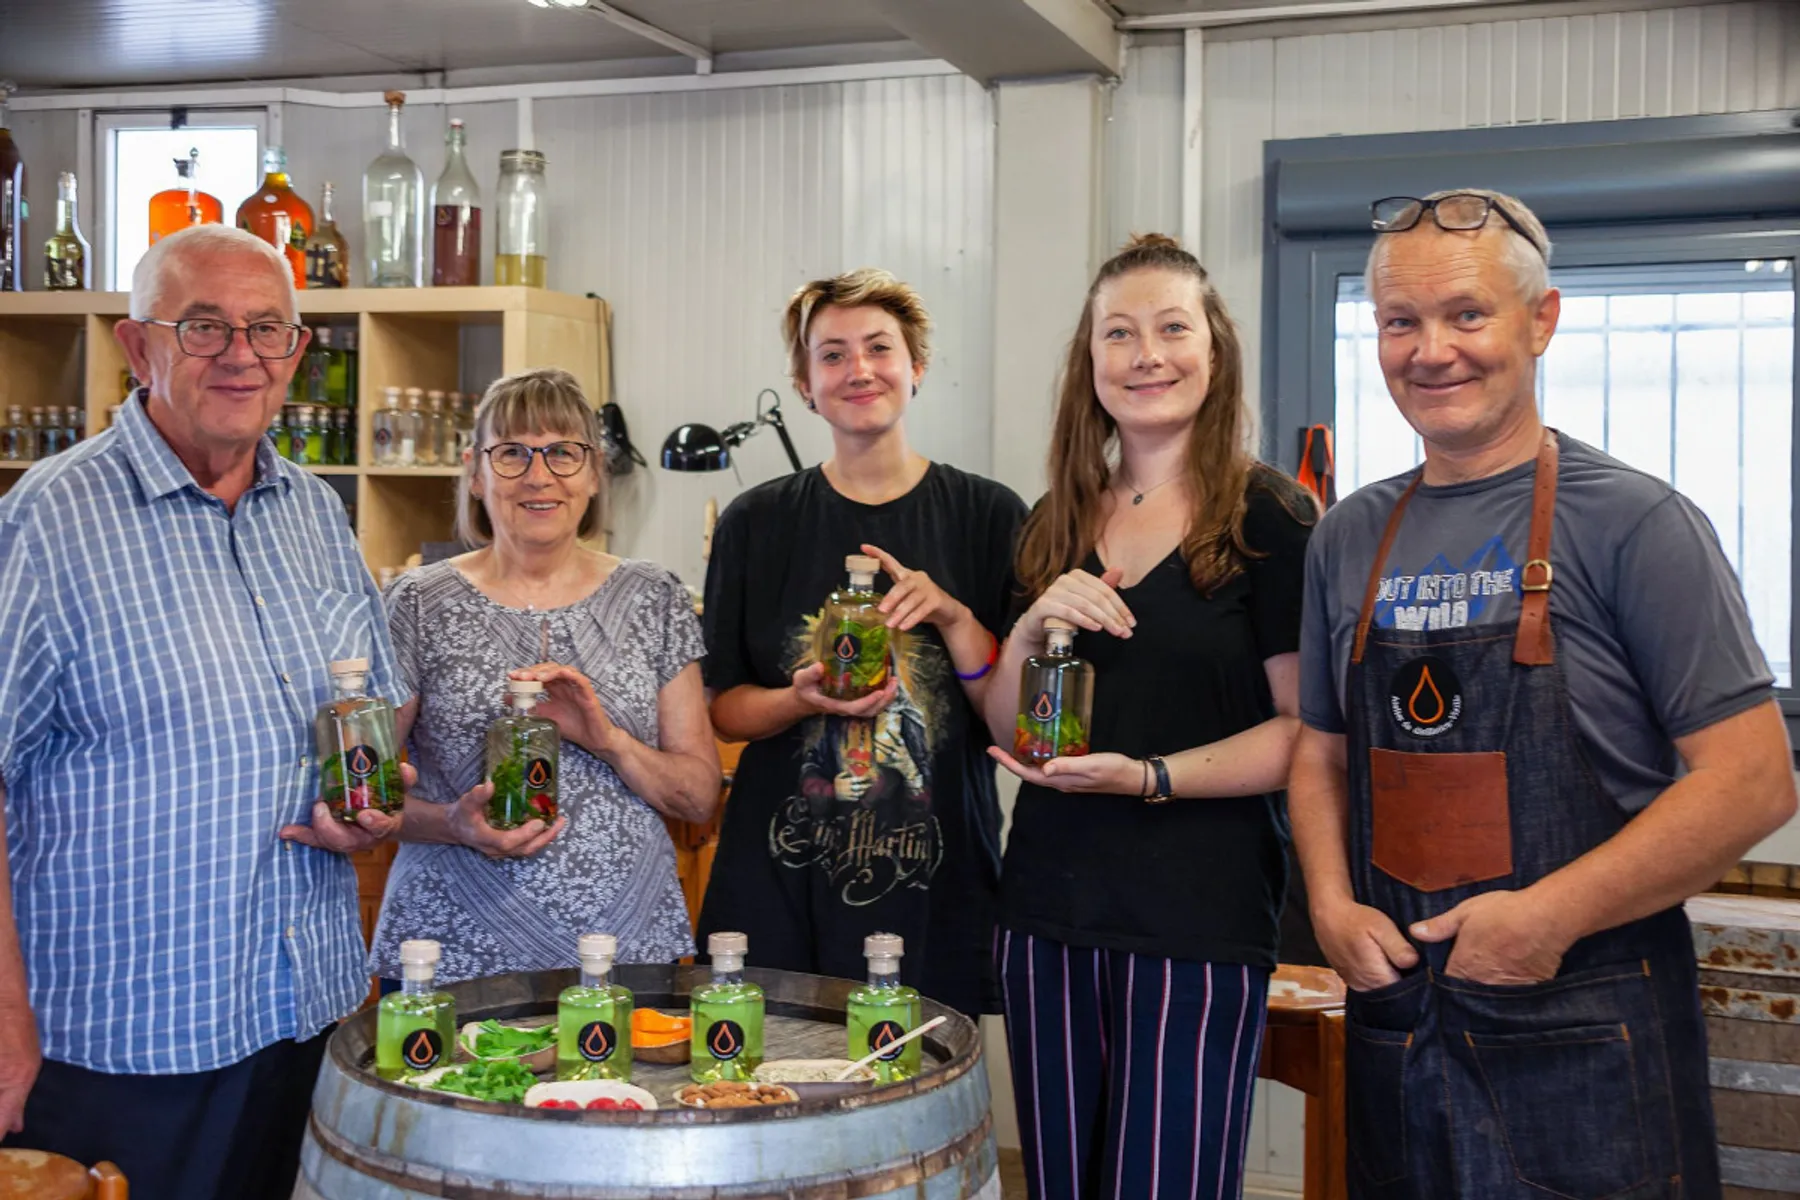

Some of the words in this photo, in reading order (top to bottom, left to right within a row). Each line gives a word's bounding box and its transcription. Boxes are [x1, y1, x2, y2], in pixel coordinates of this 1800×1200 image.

[1417, 573, 1467, 601] INTO
[1471, 569, 1514, 596] THE
[1394, 601, 1468, 631] WILD
